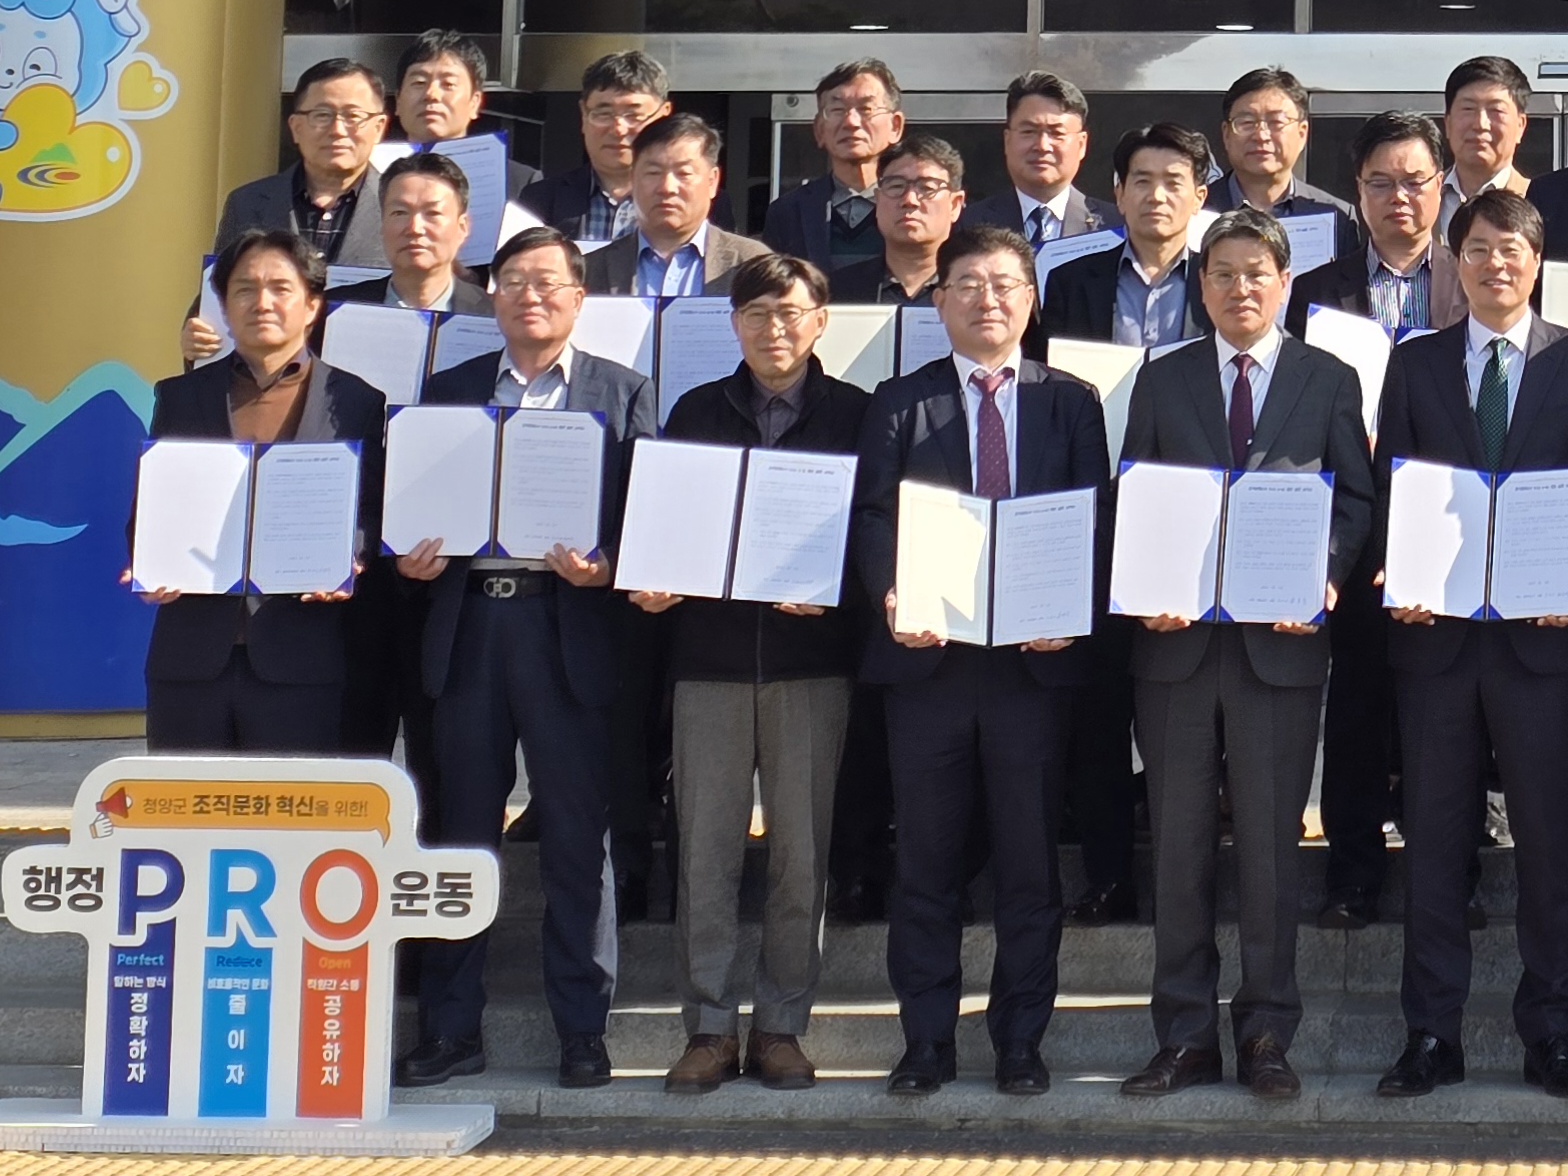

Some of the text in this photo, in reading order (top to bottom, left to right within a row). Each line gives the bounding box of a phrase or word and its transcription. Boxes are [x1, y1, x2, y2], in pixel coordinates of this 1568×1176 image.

[143, 795, 368, 817] 청양군 조직문화 혁신을 위한!
[22, 848, 474, 940] 행정 PRO 운동
[117, 954, 165, 966] Perfect
[319, 957, 351, 969] Open
[127, 993, 148, 1083] 정확하자
[321, 995, 341, 1086] 공유하자
